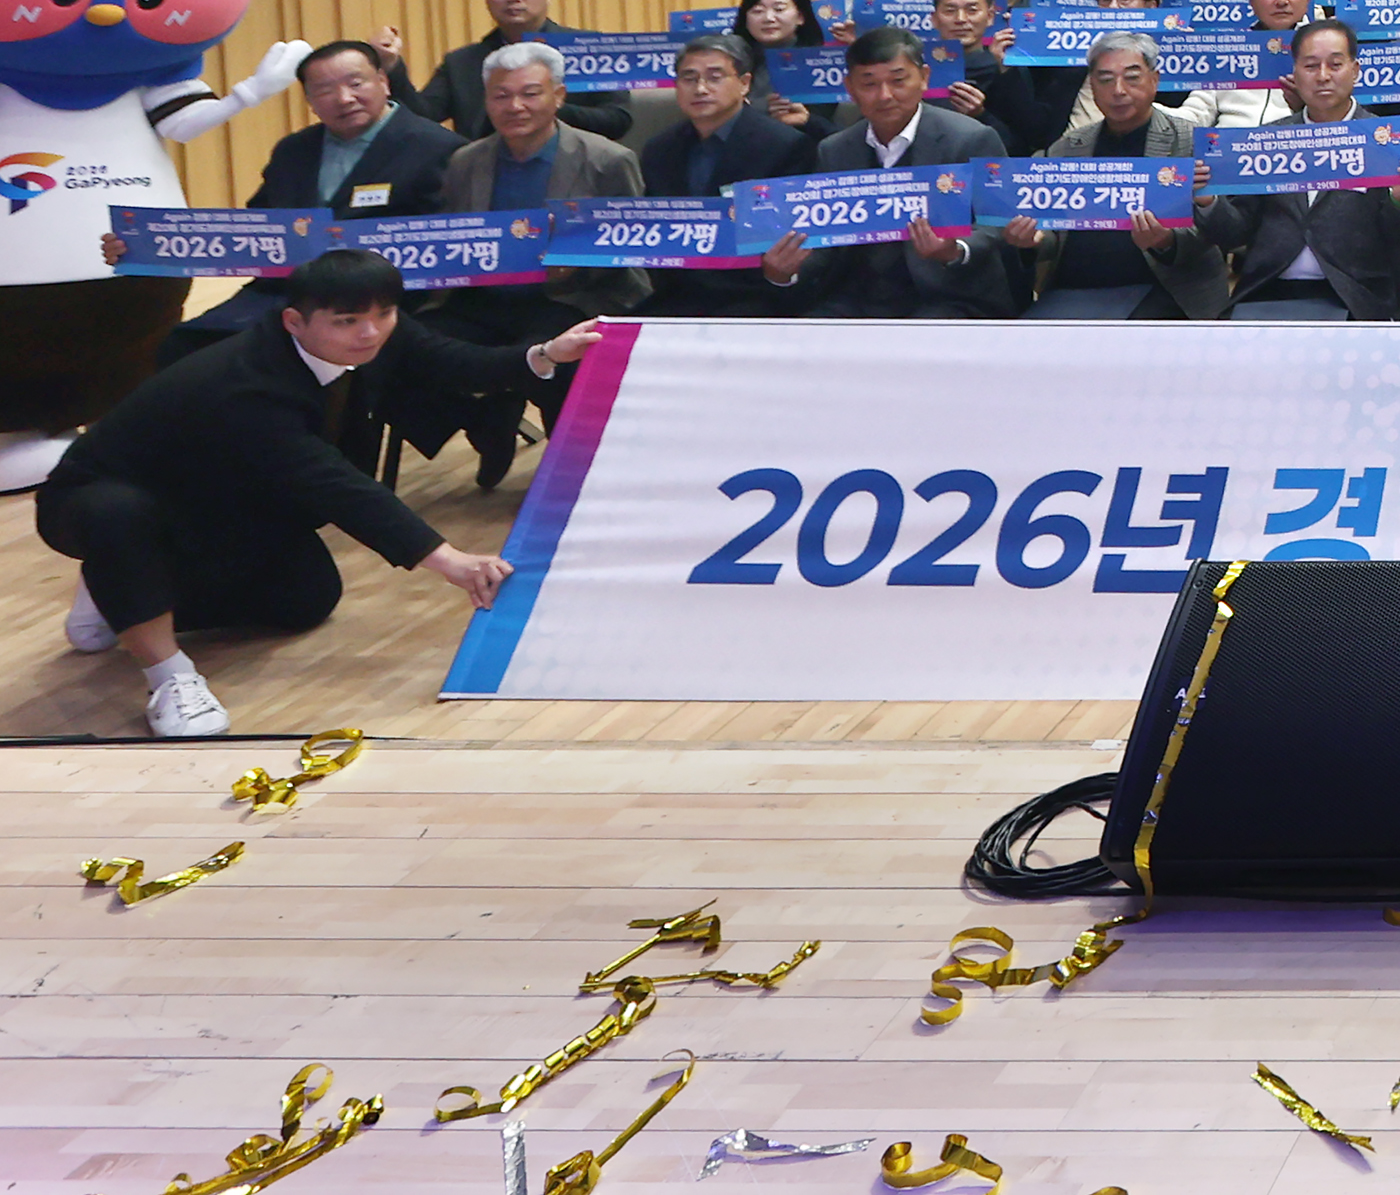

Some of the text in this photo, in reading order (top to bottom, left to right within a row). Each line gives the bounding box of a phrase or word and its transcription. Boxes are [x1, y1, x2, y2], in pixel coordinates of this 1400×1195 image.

[1192, 5, 1242, 22] 2026
[1155, 55, 1259, 78] 2026 가평
[1248, 132, 1275, 141] Again
[66, 165, 108, 176] 2026
[1238, 148, 1365, 176] 2026 가평
[64, 176, 151, 190] GaPyeong
[792, 195, 928, 228] 2026 가평
[1015, 186, 1146, 215] 2026 가평
[154, 235, 287, 264] 2026 가평
[594, 222, 719, 254] 2026 가평
[446, 240, 499, 272] 가평
[687, 465, 1229, 595] 2026년
